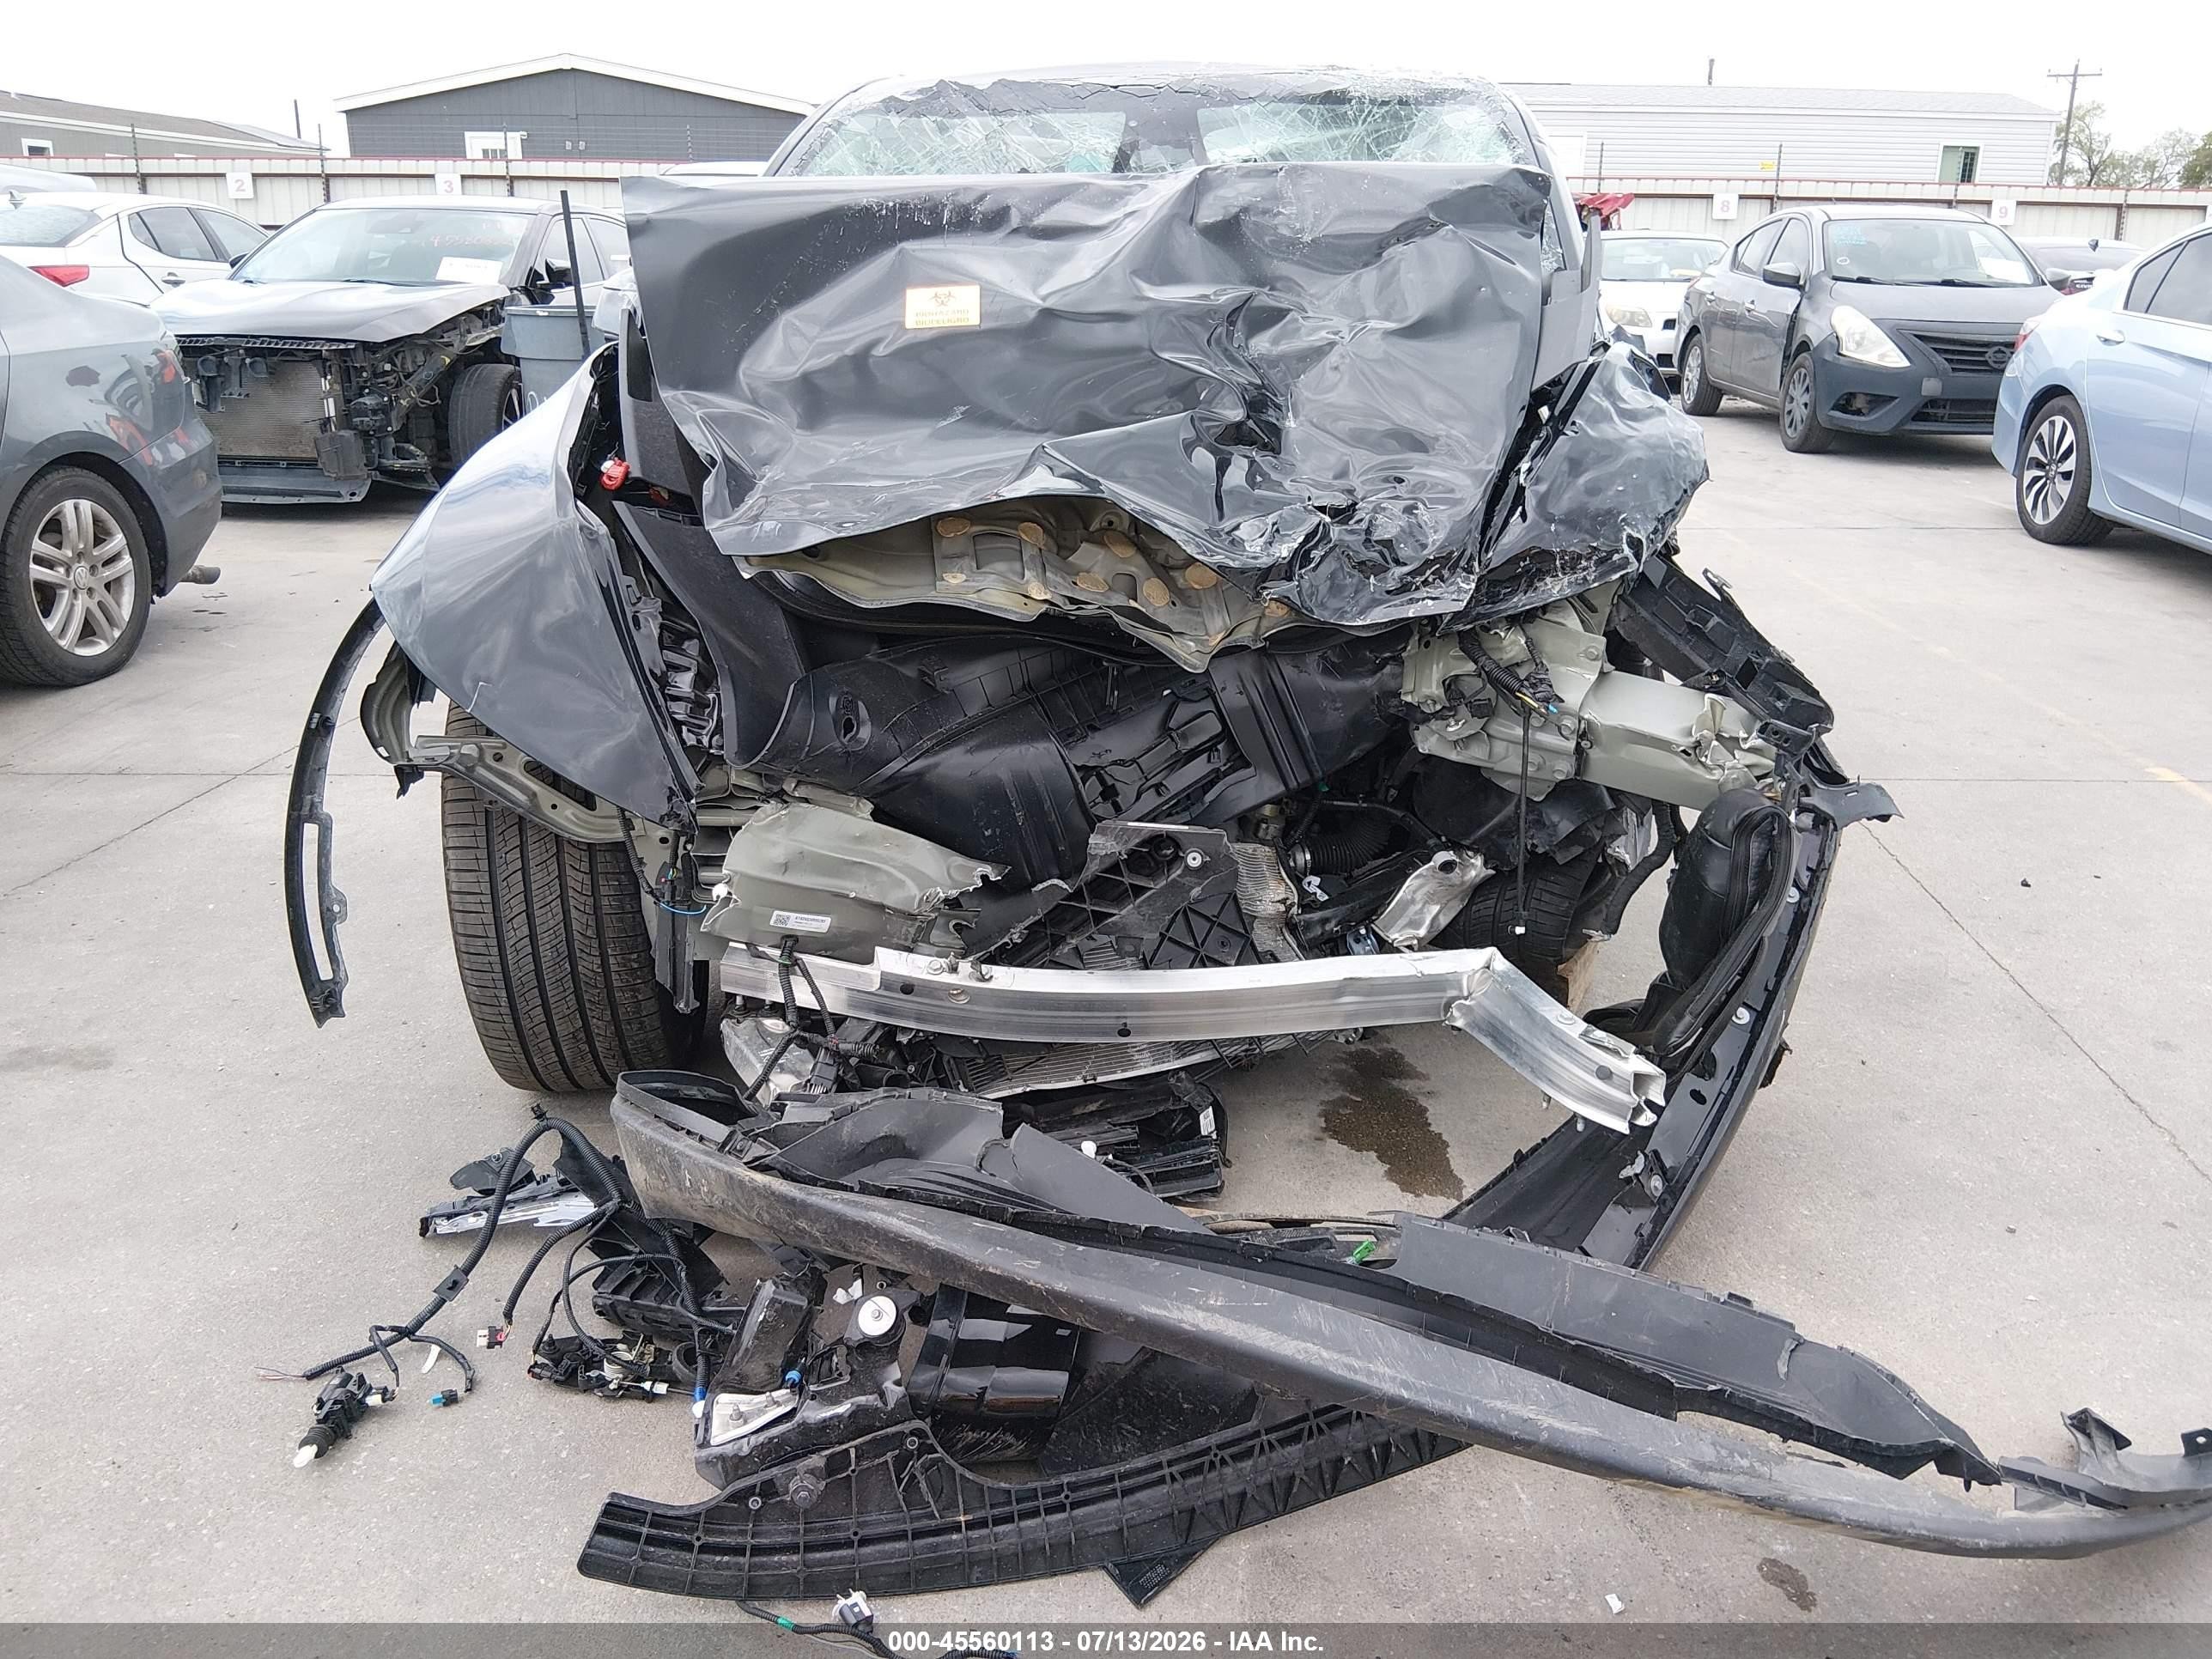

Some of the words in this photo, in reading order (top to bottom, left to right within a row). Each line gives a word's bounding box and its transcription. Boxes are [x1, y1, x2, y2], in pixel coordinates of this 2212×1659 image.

[234, 179, 246, 191] 2
[444, 180, 453, 193] 3
[1721, 200, 1730, 212] 8
[1999, 206, 2008, 218] 9
